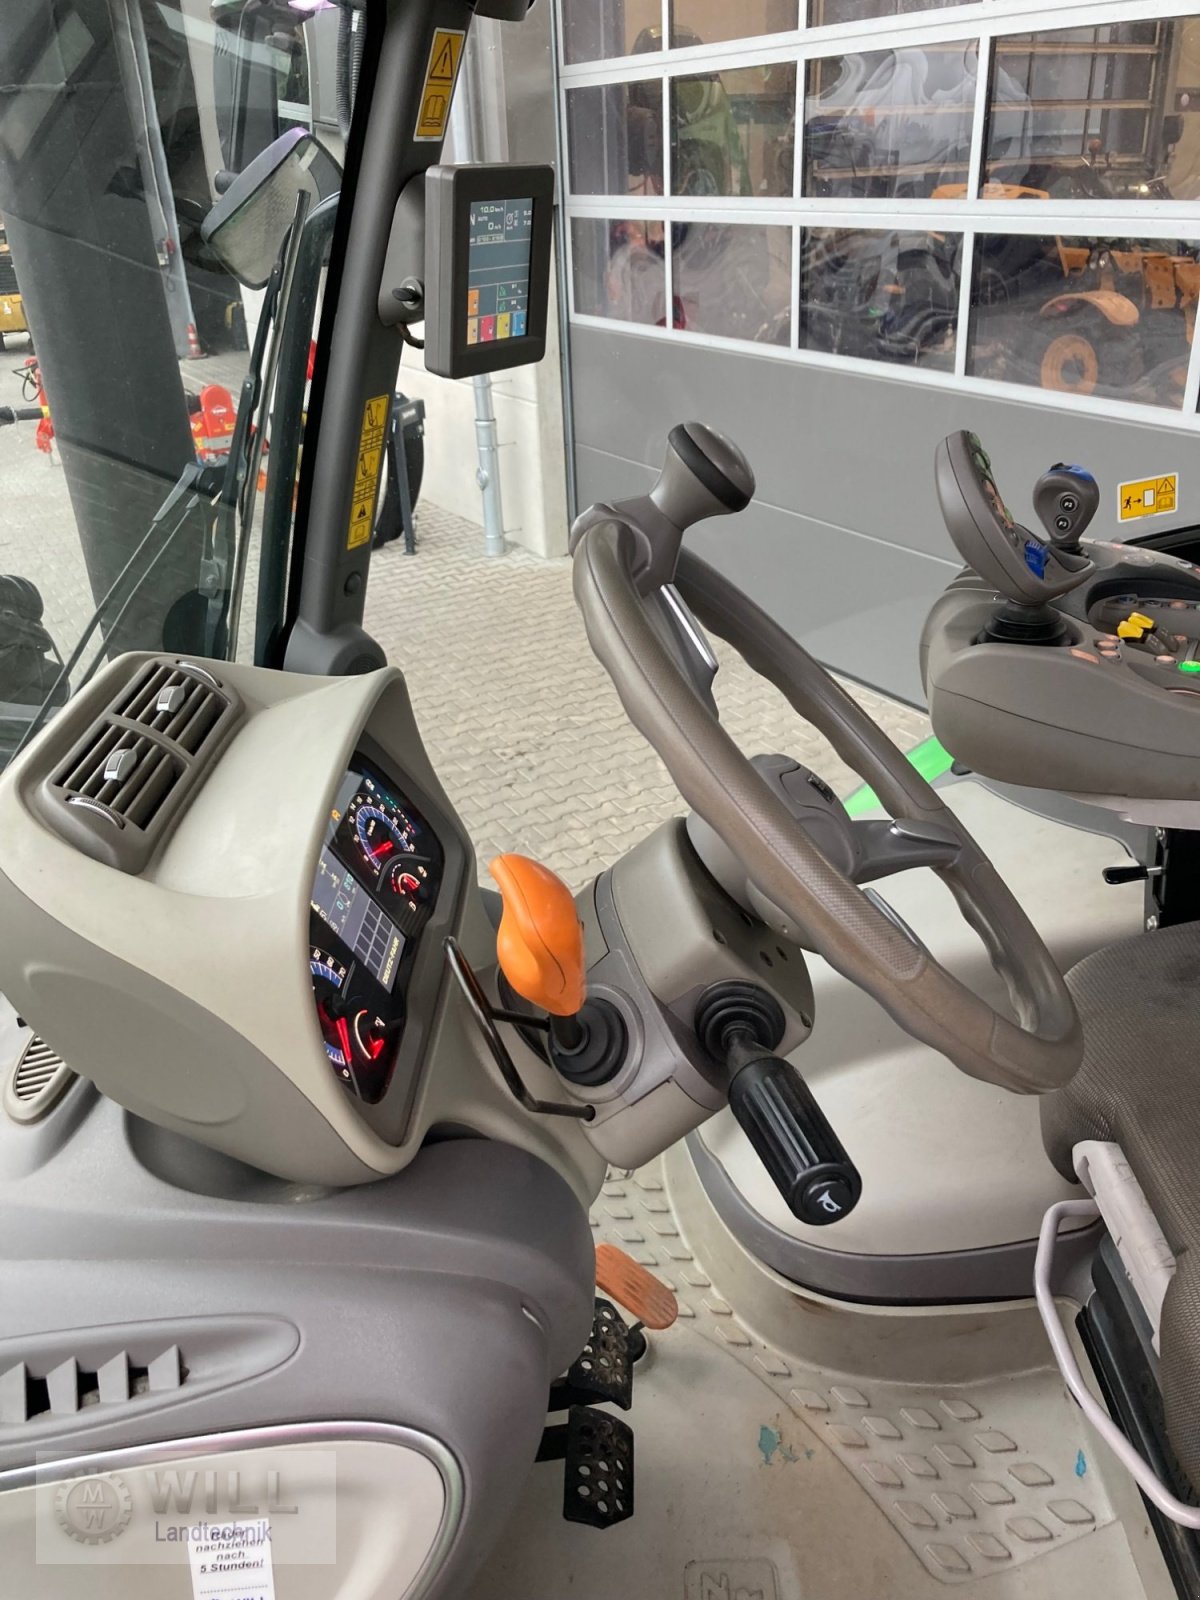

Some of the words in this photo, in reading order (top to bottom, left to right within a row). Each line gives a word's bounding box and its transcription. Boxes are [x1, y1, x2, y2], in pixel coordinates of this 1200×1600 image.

[382, 936, 400, 985] DEUTZ-FAHR
[196, 1539, 264, 1553] nachziehen
[216, 1551, 245, 1561] nach
[201, 1564, 207, 1573] 5
[211, 1558, 264, 1572] Stunden!
